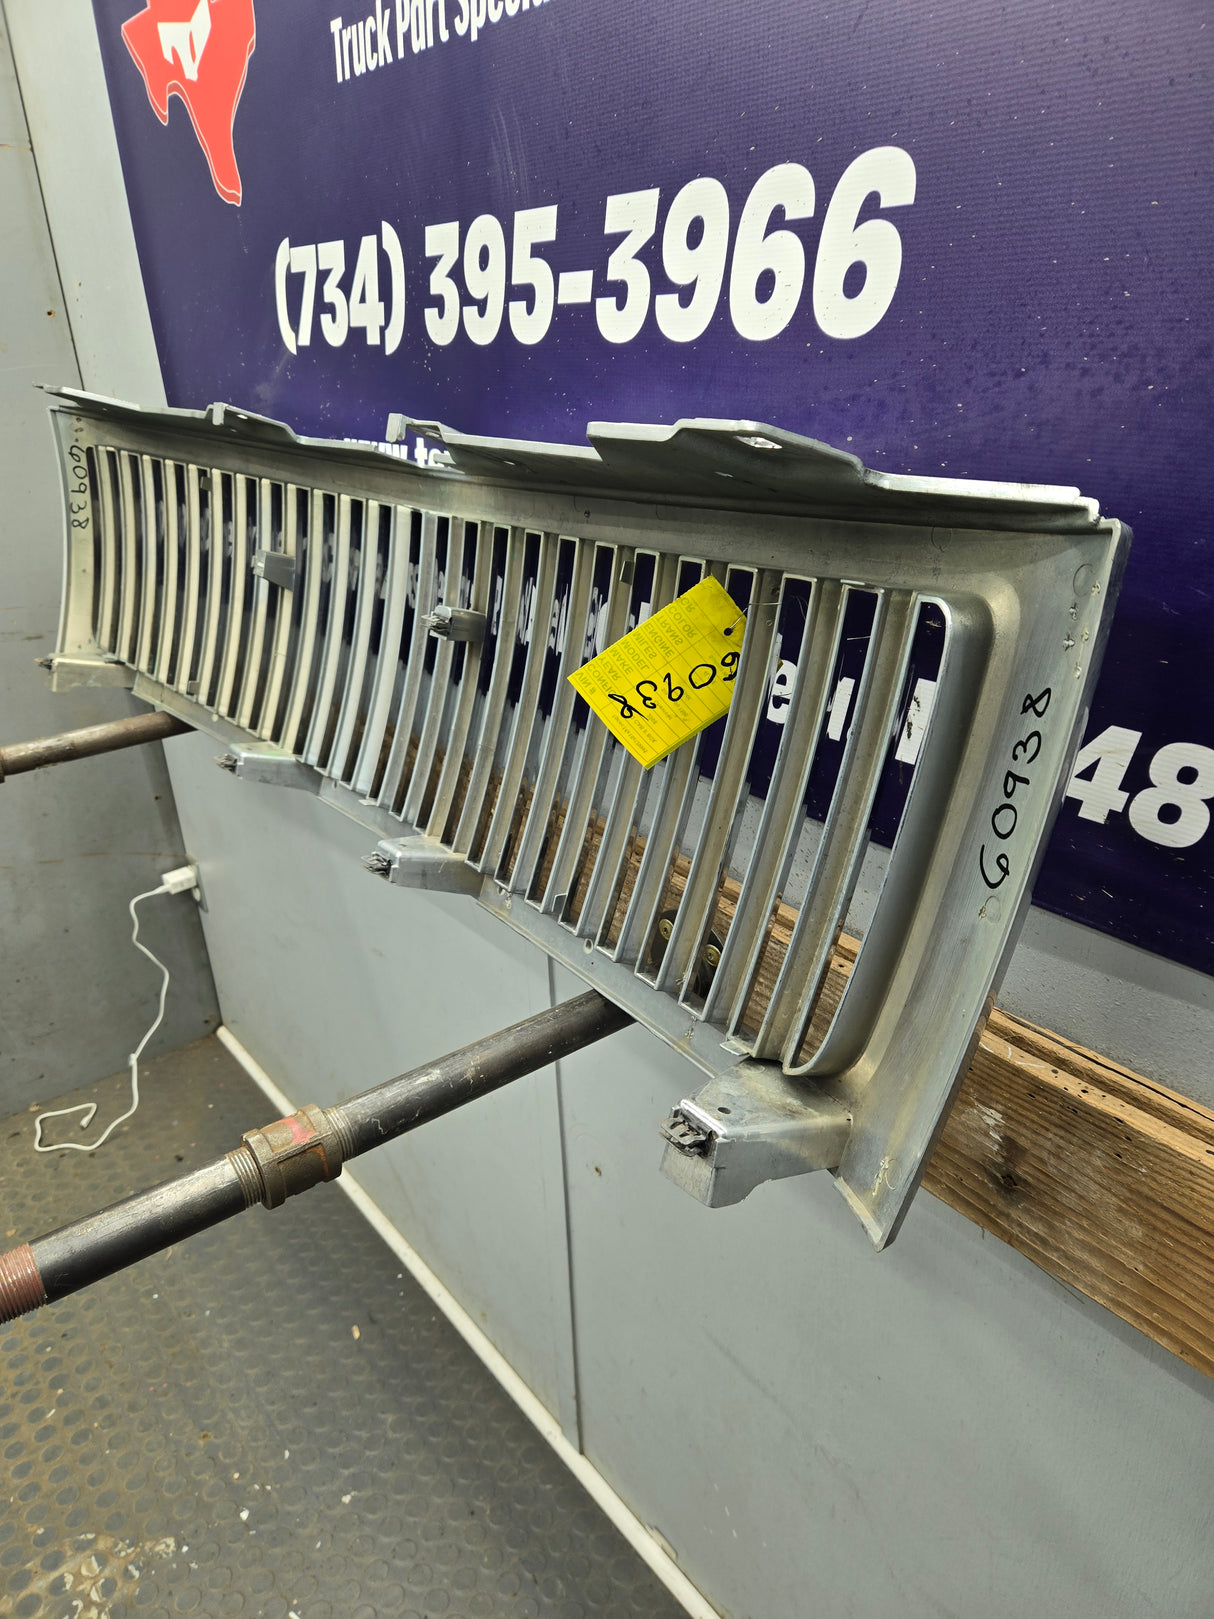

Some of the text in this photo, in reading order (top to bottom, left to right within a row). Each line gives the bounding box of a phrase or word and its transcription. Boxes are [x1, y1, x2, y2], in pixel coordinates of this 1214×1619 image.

[330, 0, 393, 83] Truck
[395, 0, 449, 60] Part
[275, 145, 917, 356] (734) 395-3966
[67, 444, 90, 530] 60938
[607, 652, 740, 721] 60938
[980, 687, 1052, 890] 60938
